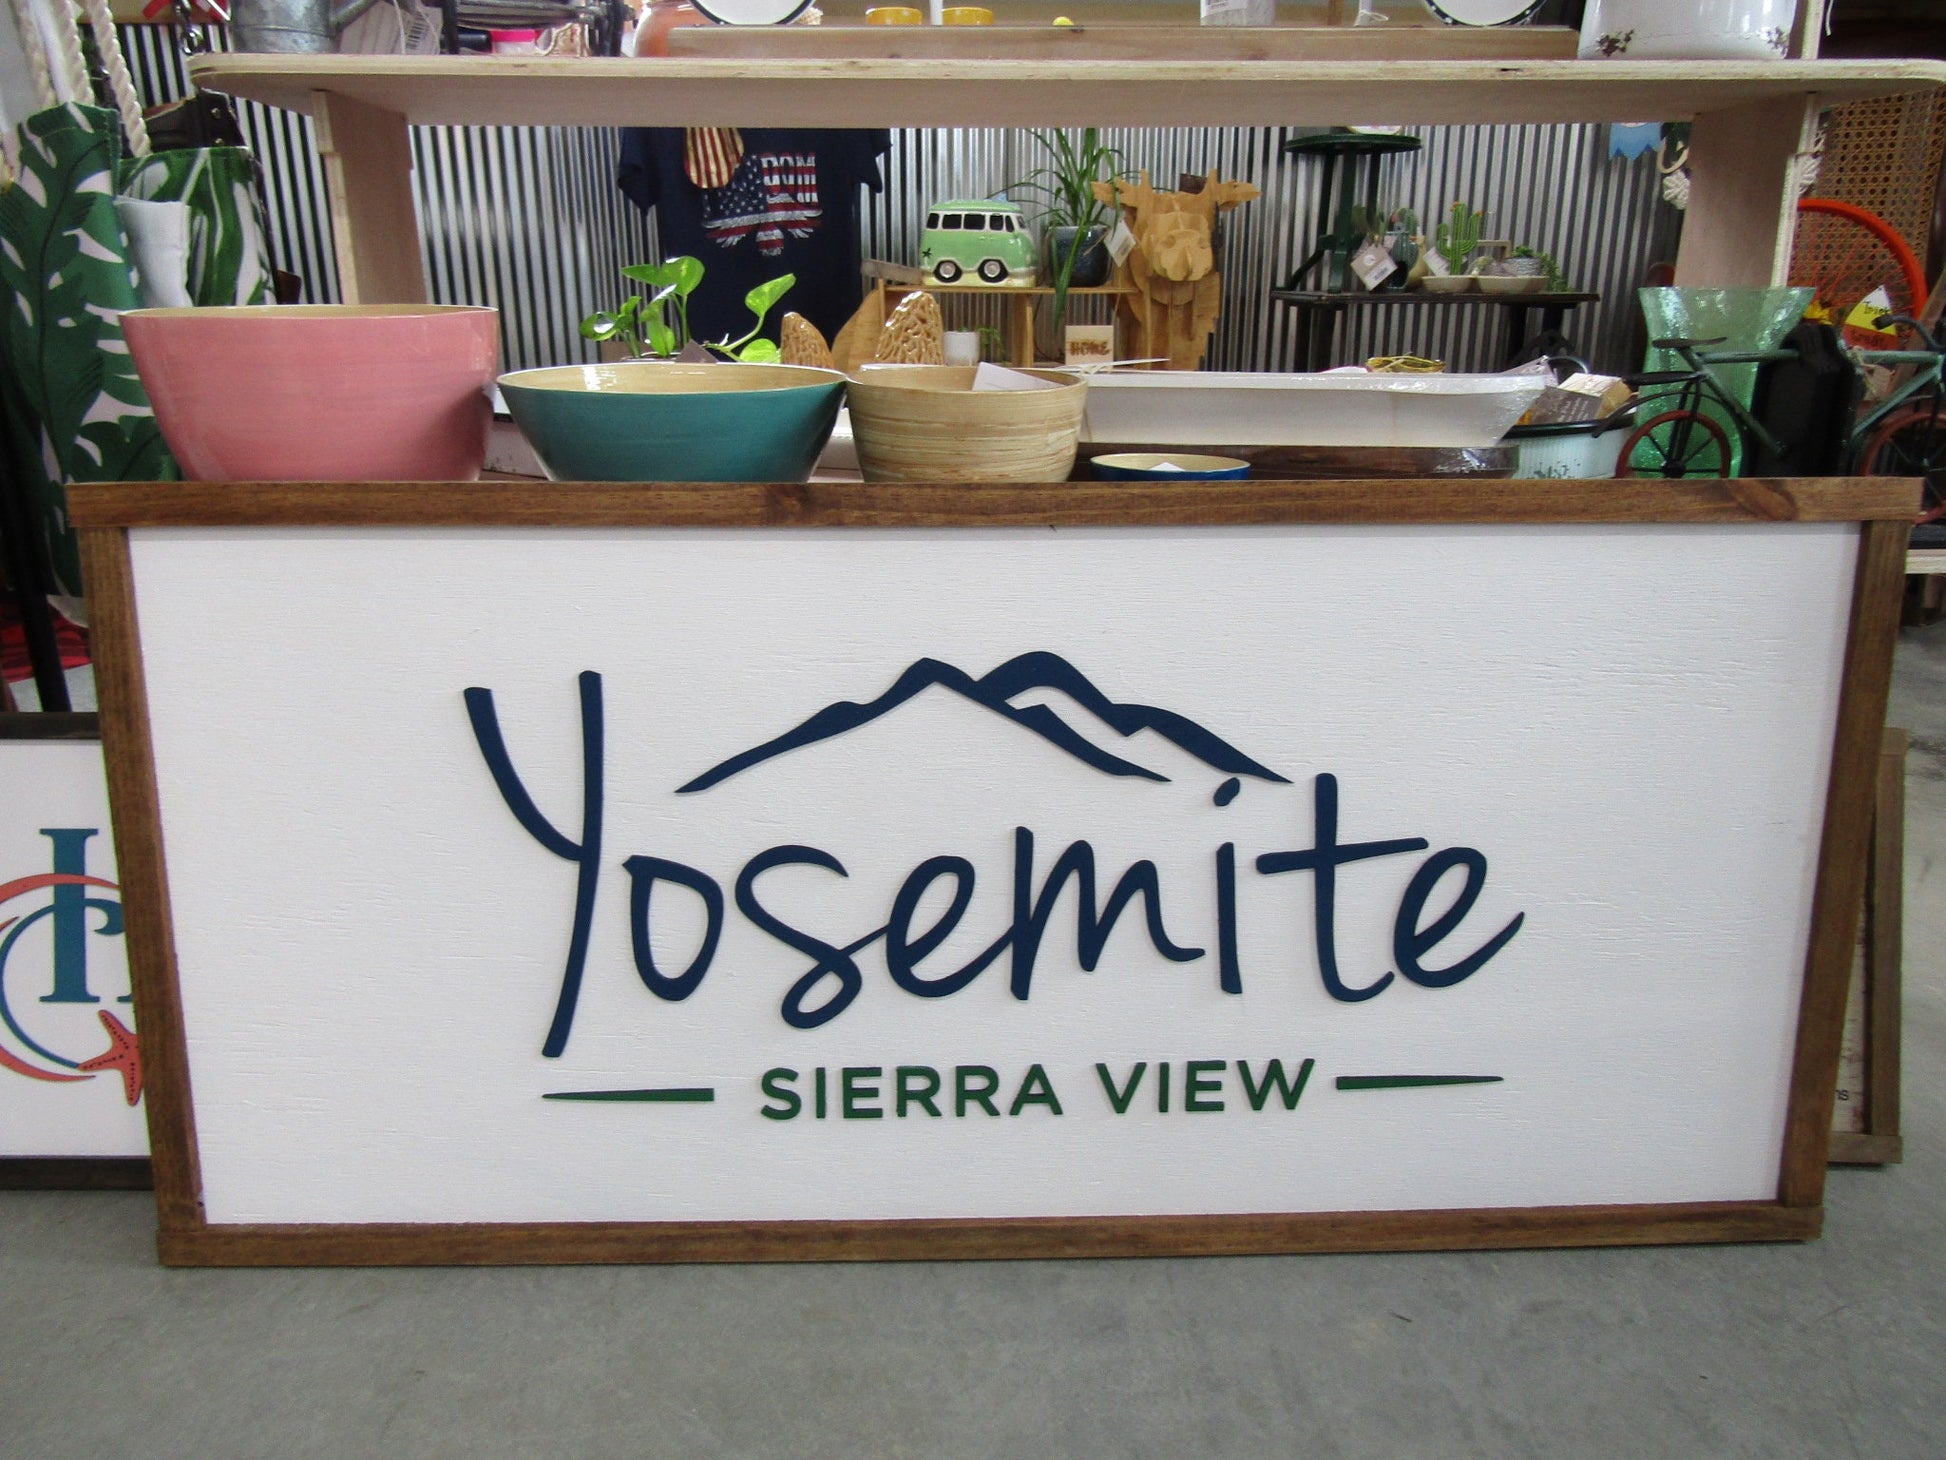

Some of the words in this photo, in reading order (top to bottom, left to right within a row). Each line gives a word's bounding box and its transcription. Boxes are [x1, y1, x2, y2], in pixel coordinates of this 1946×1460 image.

[464, 671, 1525, 1059] Yosemite
[760, 1063, 1064, 1121] SIERRA
[1095, 1058, 1316, 1115] VIEW
